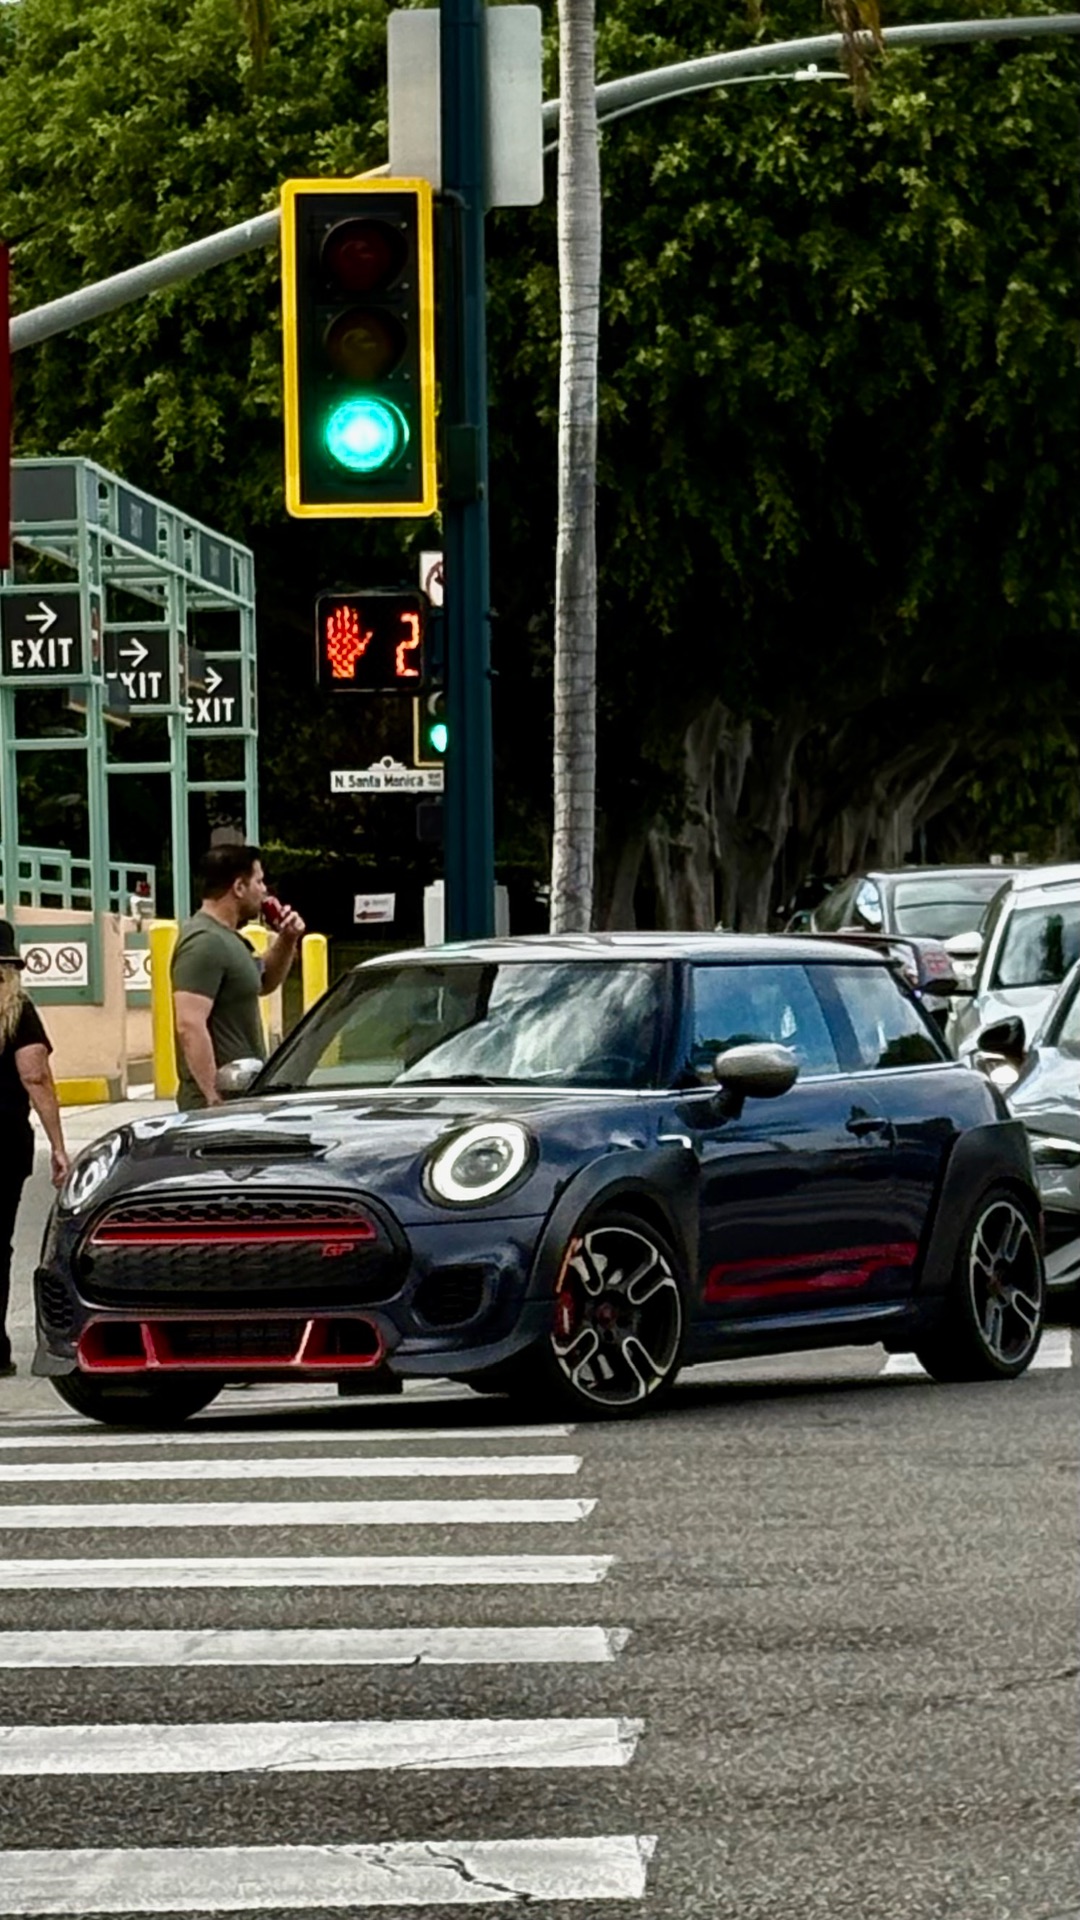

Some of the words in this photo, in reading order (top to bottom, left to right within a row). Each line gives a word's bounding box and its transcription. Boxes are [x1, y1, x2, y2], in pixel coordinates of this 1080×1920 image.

[11, 638, 73, 668] EXIT
[396, 612, 419, 677] 2
[106, 671, 162, 698] XIT
[348, 775, 381, 788] Santa
[384, 774, 424, 787] Monica
